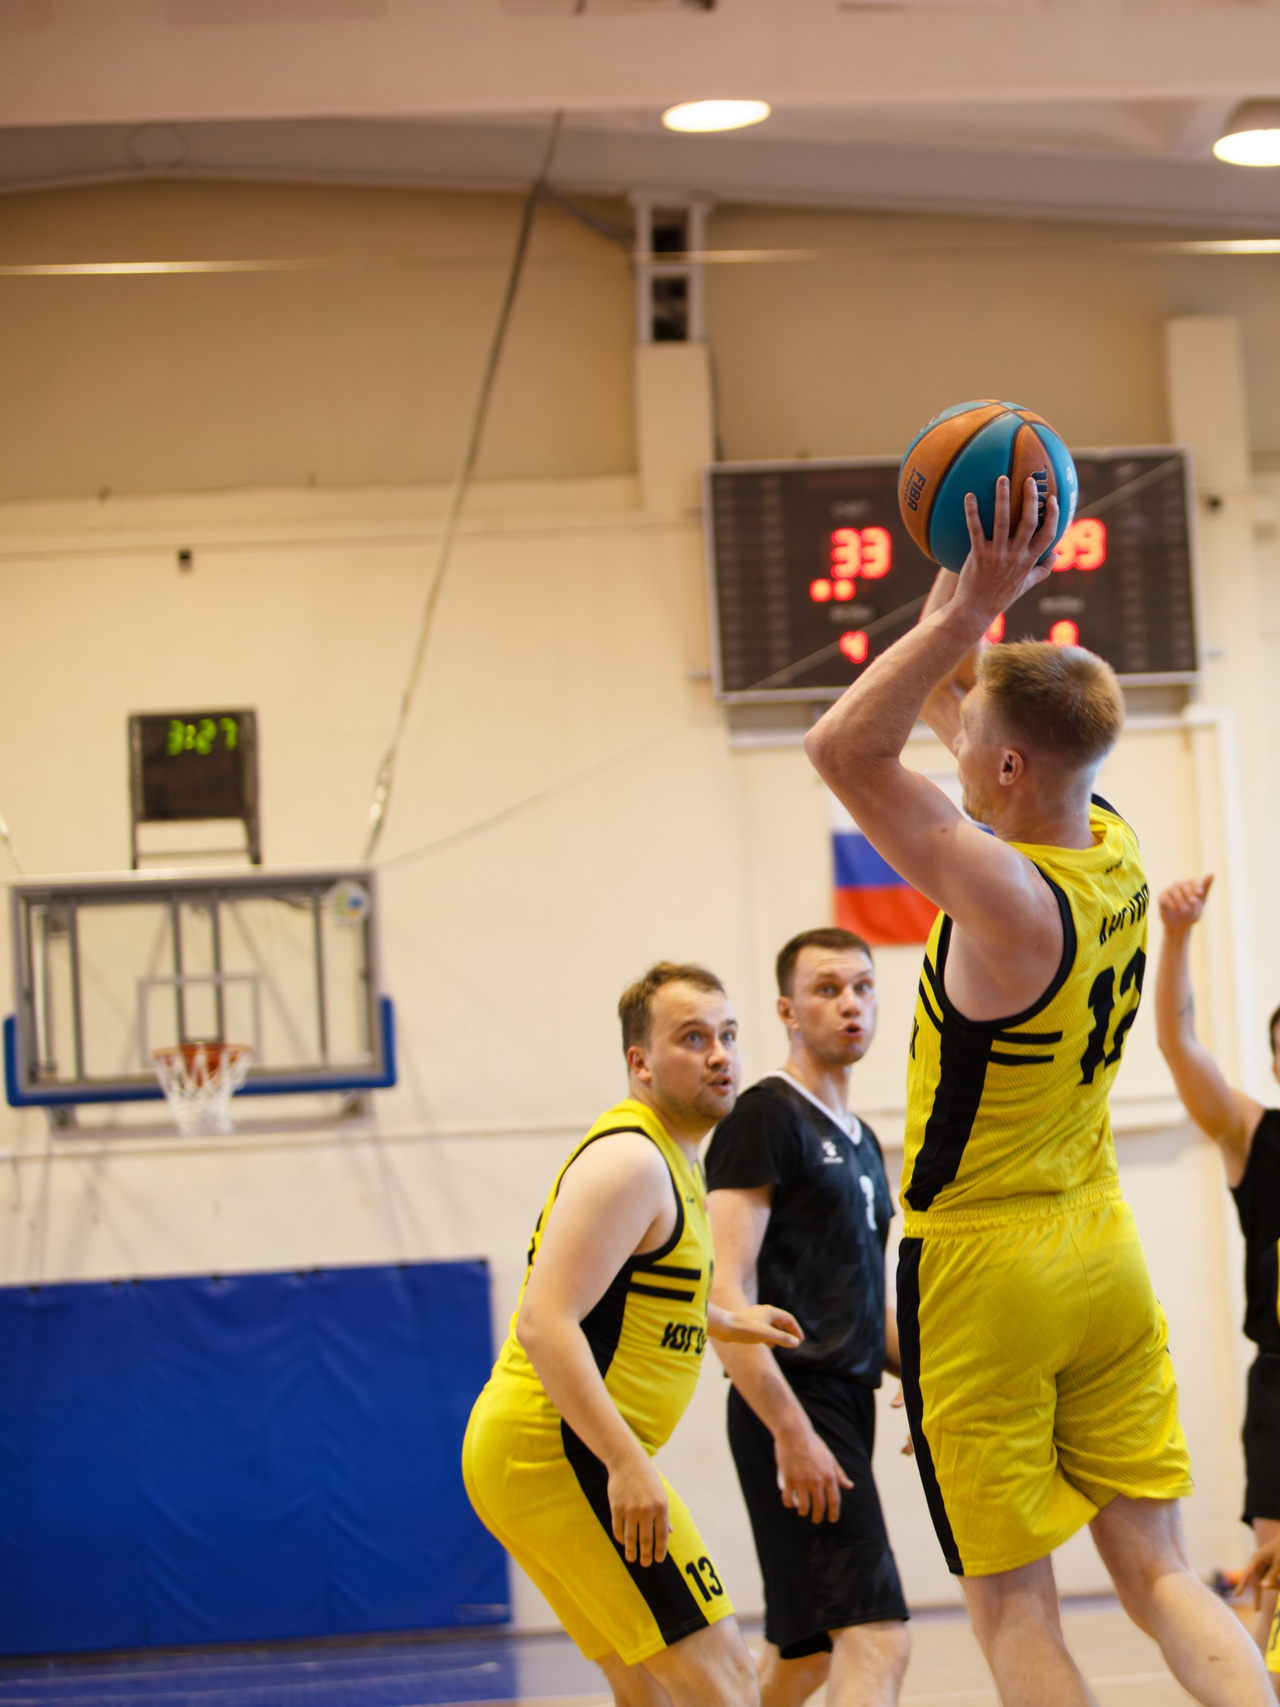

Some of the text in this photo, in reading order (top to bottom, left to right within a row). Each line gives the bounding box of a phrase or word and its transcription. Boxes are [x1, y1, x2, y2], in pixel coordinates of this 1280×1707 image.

[907, 471, 927, 511] FIBA
[831, 527, 891, 579] 33
[1077, 947, 1146, 1086] 12
[685, 1556, 723, 1603] 13
